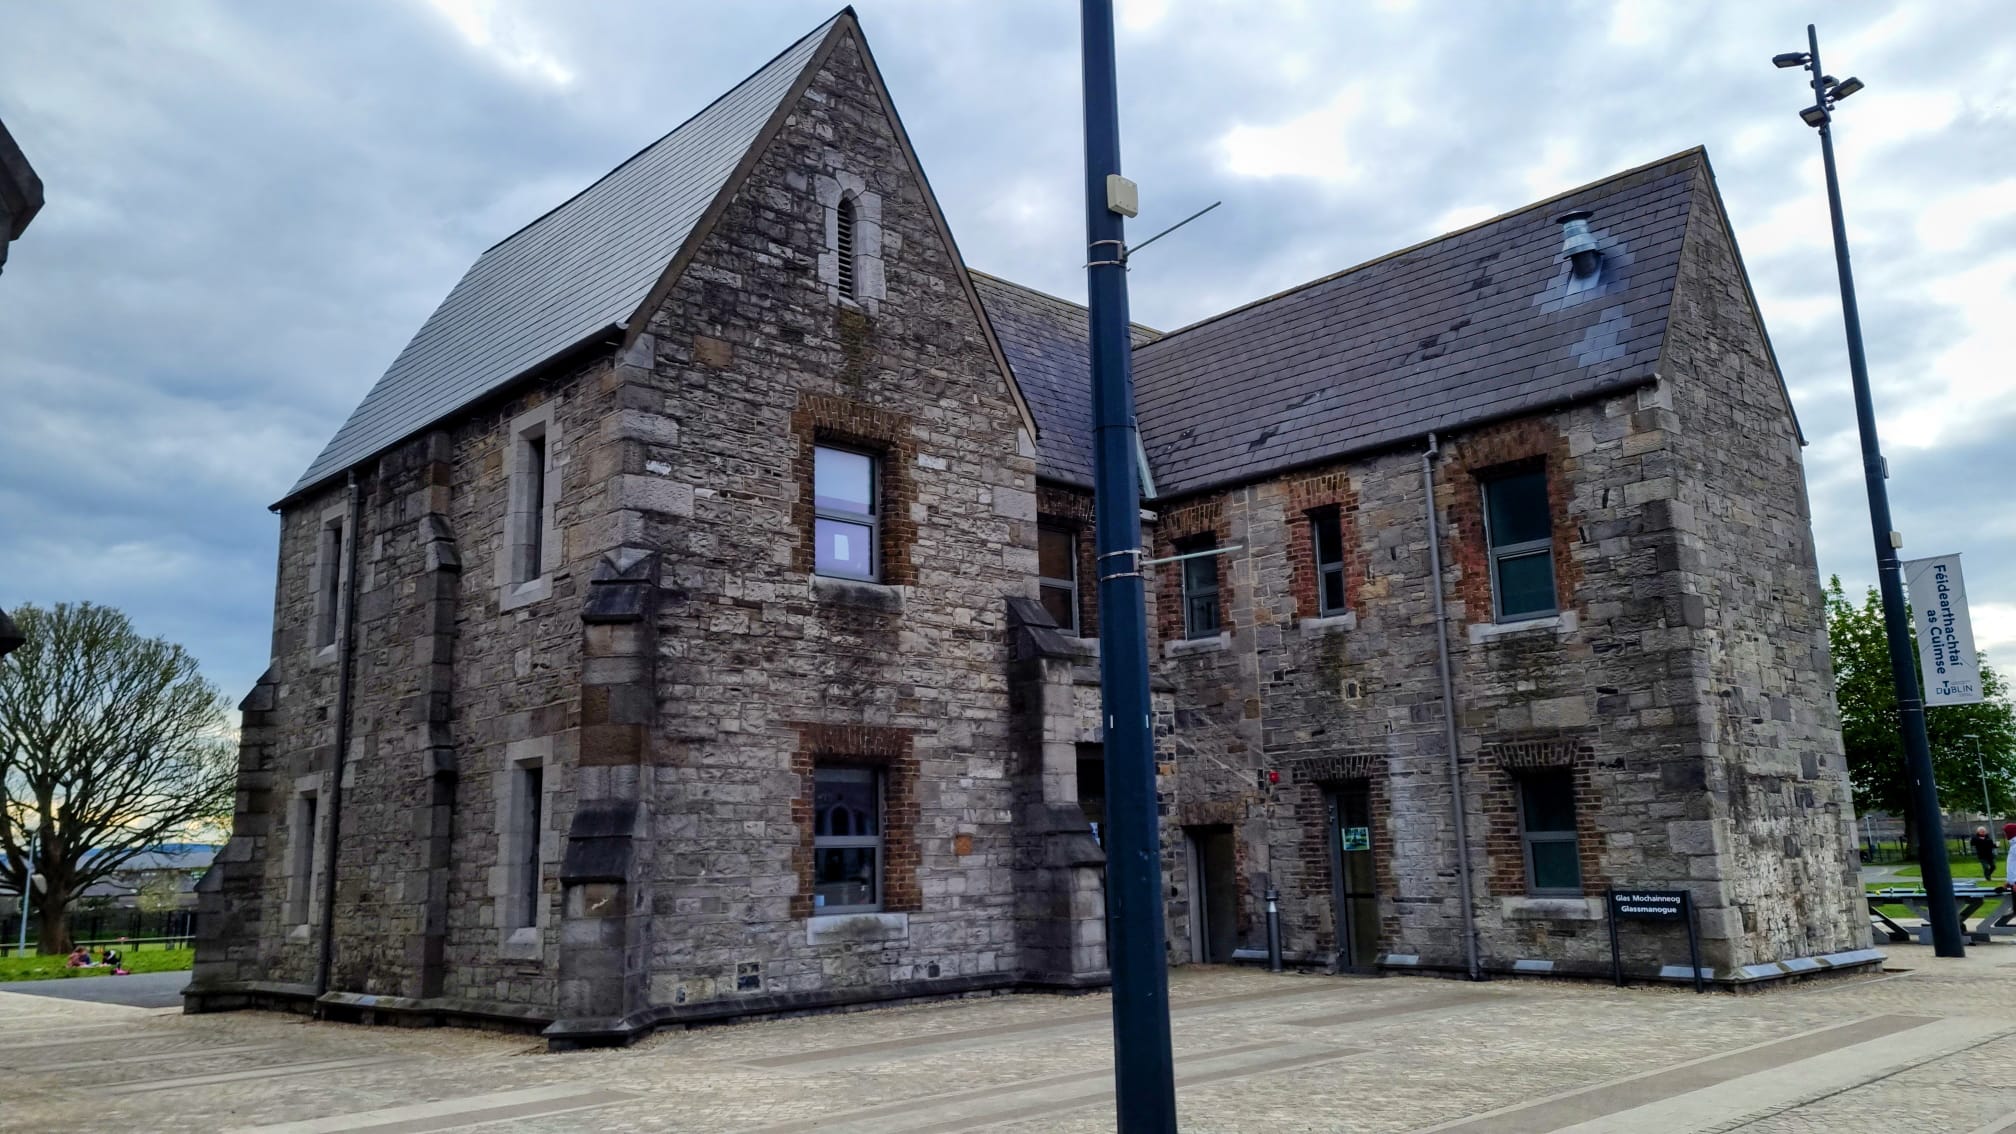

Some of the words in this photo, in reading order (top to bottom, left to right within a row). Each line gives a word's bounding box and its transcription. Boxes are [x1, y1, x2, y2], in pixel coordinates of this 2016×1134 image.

[1927, 609, 1937, 623] as
[1934, 564, 1963, 666] Féidearthachtaí
[1930, 626, 1946, 675] Cuimse
[1615, 894, 1631, 902] Glas
[1621, 905, 1677, 914] Glassmanogue
